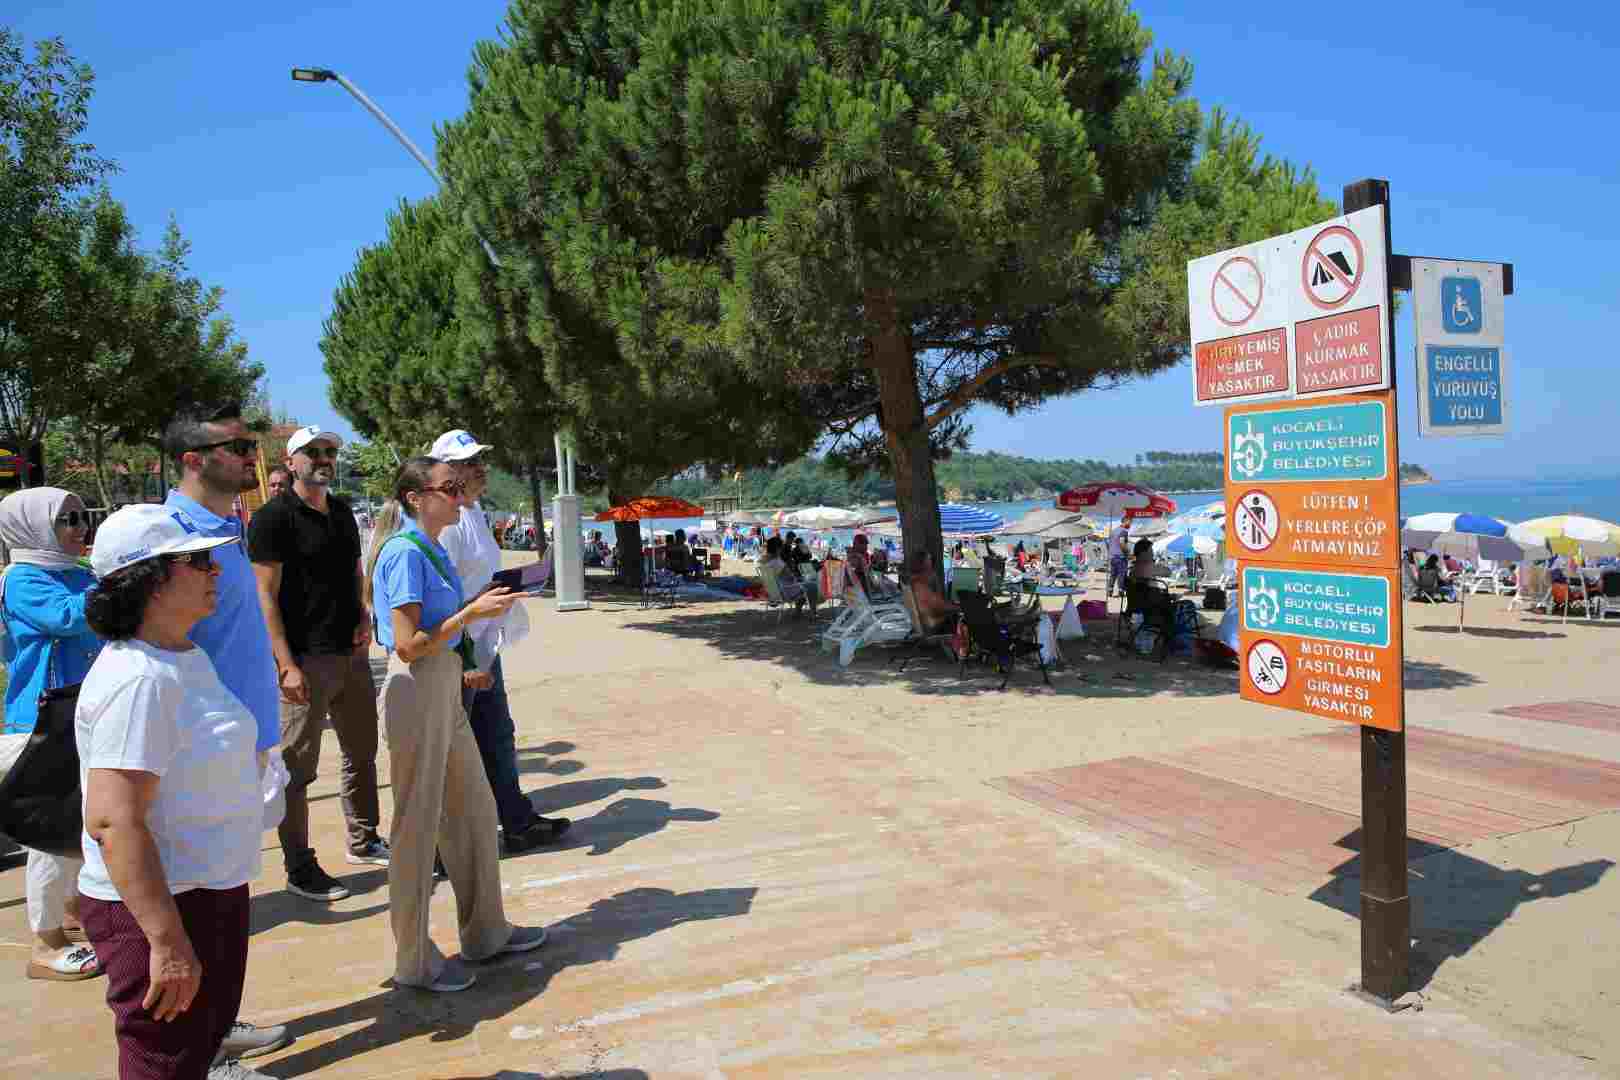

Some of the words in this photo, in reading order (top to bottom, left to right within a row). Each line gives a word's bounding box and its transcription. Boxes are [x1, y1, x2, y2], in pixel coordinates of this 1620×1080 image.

[1312, 320, 1361, 346] ÇADIR
[1305, 342, 1369, 366] KURMAK
[1217, 358, 1264, 374] YEMEK
[1303, 363, 1376, 387] YASAKTIR
[1208, 374, 1275, 394] YASAKTIR
[1449, 402, 1485, 421] YOLU
[1287, 519, 1350, 535] YERLERE
[1354, 516, 1386, 539] ÇÖP
[1292, 539, 1381, 557] ATMAYINIZ
[1301, 641, 1374, 663] MOTORLU
[1304, 694, 1374, 720] YASAKTIR
